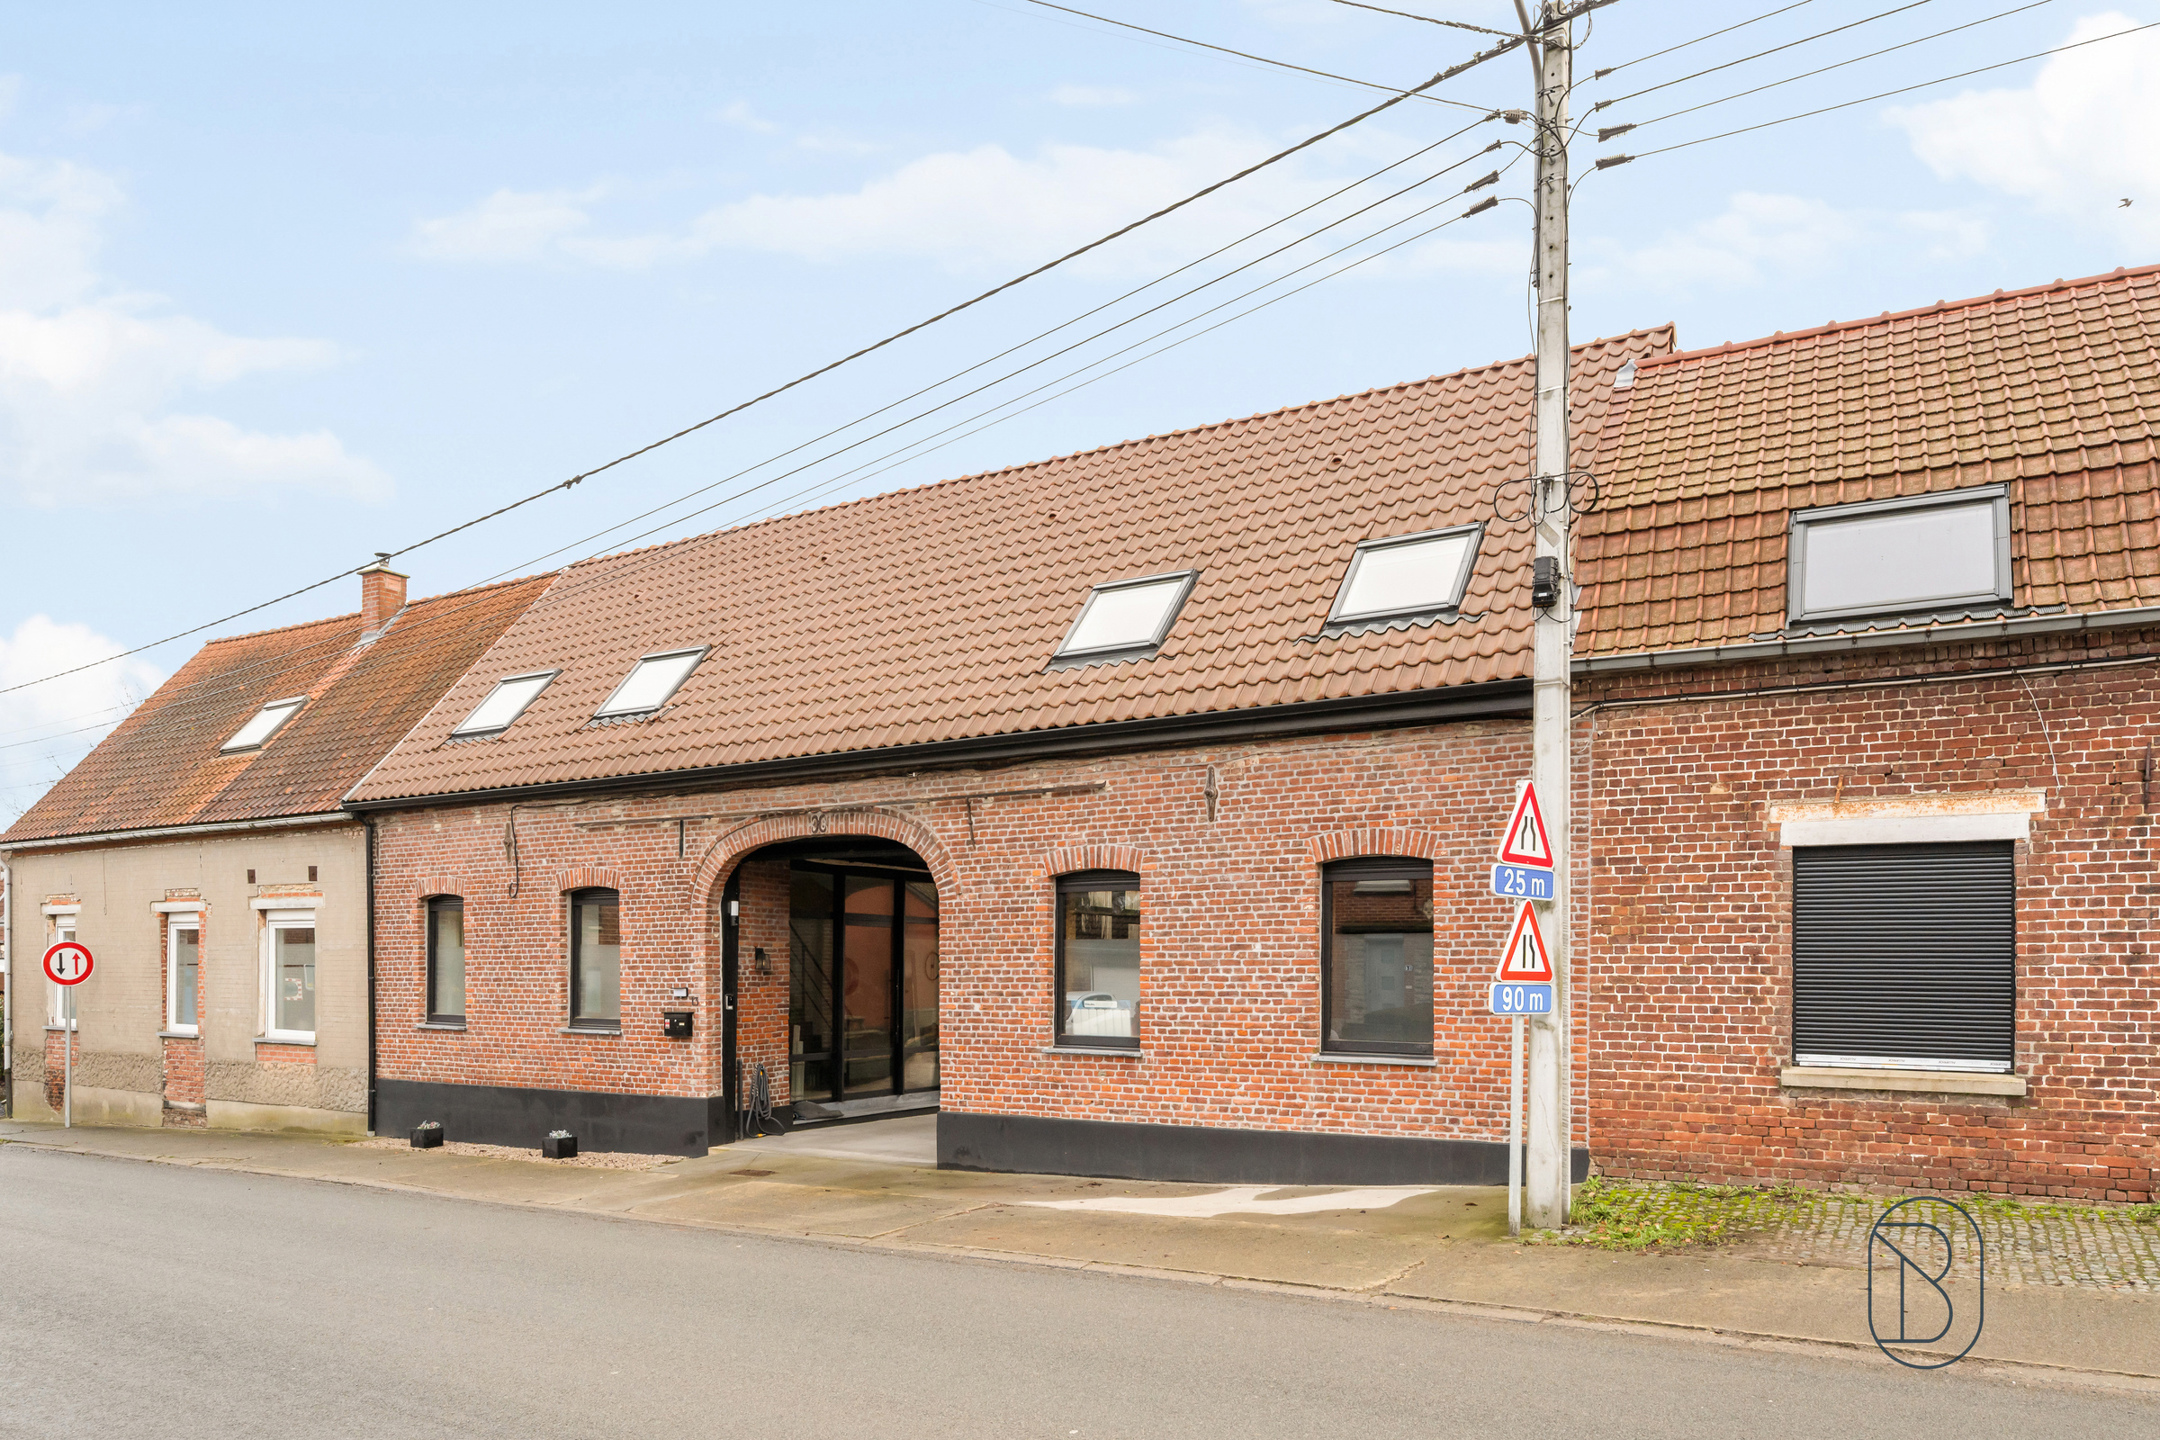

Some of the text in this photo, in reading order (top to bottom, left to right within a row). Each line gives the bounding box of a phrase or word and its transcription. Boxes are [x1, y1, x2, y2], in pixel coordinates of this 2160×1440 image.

[1504, 868, 1545, 896] 25 m
[691, 996, 699, 1006] 13
[1502, 986, 1543, 1011] 90 m
